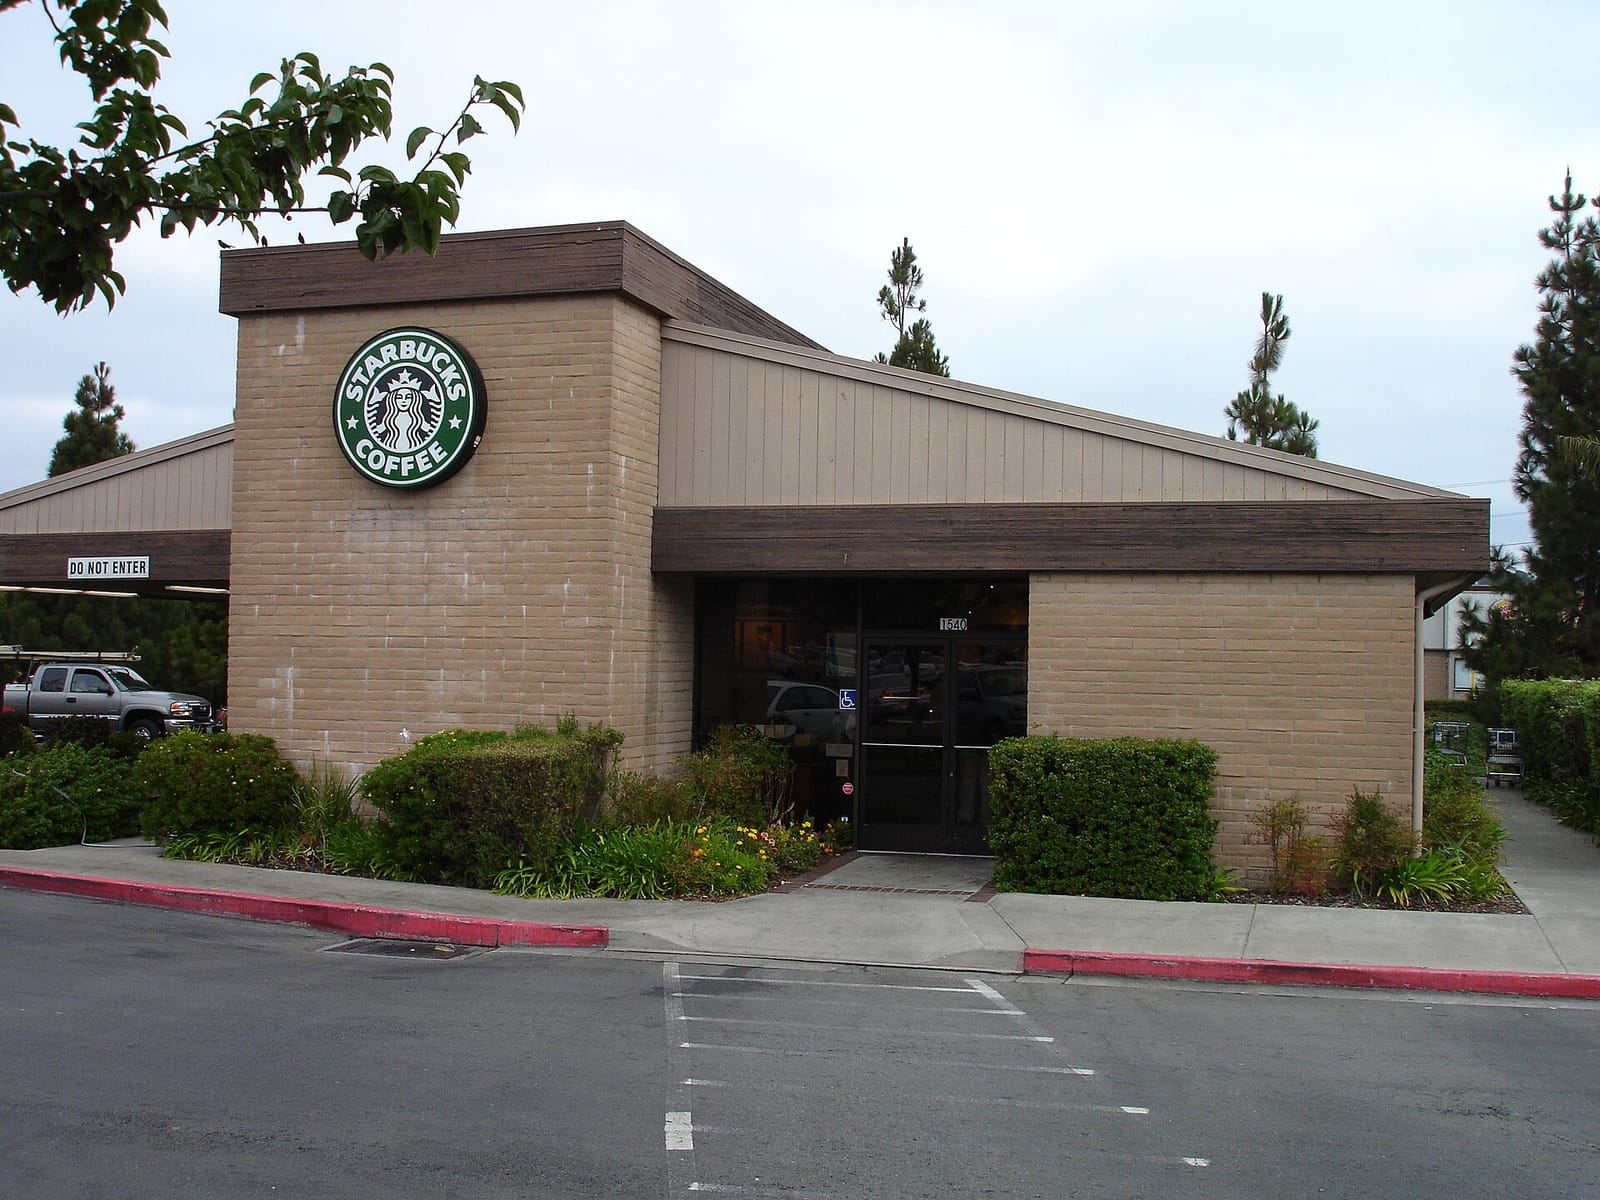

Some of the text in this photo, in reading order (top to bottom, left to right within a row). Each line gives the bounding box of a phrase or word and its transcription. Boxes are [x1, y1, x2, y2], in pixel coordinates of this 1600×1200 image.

[346, 340, 466, 402] STARBUCKS
[355, 438, 448, 477] COFFEE
[70, 561, 146, 575] DO NOT ENTER
[941, 618, 967, 630] 1540
